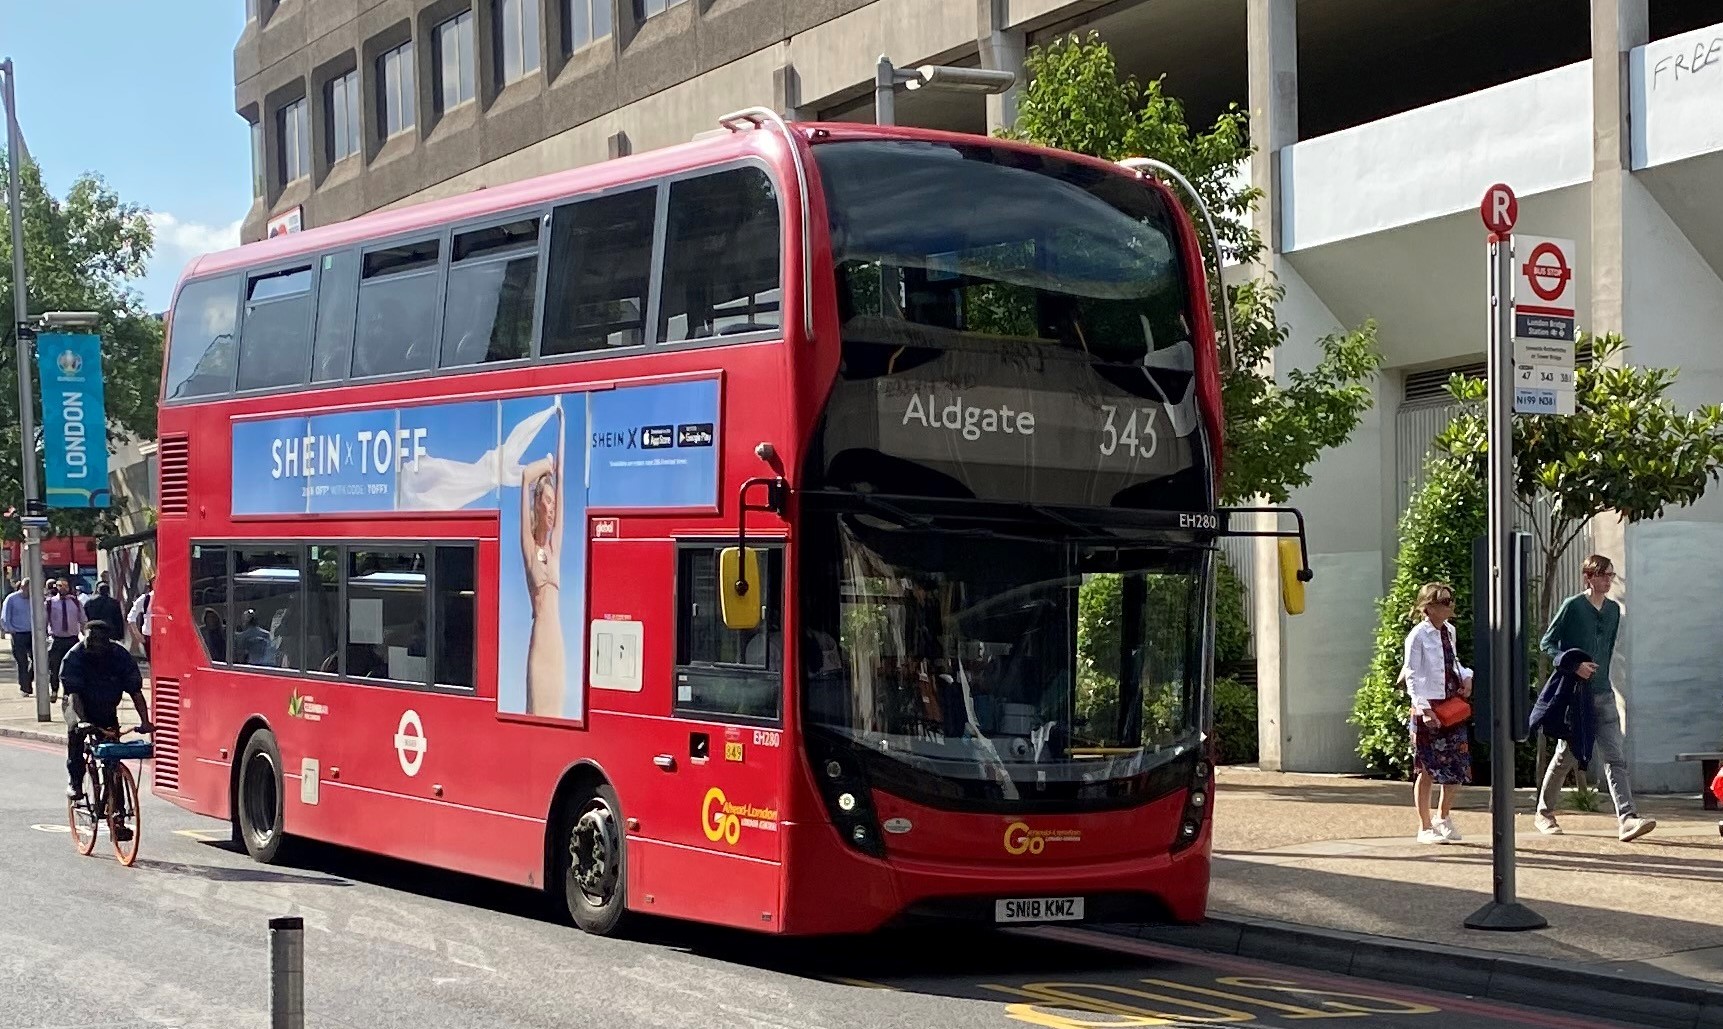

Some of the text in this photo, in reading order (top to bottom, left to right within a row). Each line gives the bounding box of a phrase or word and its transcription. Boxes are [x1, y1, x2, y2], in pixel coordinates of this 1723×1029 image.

[1492, 190, 1512, 226] R
[1534, 266, 1562, 277] BUS STOP
[1528, 327, 1549, 336] Station
[1522, 371, 1531, 380] 47
[1541, 372, 1554, 381] 343
[1516, 395, 1536, 405] N199
[902, 393, 1158, 458] Aldgate 343
[63, 391, 87, 479] LONDON
[592, 431, 624, 448] SHEIN
[271, 433, 341, 479] SHEIN
[357, 427, 427, 475] TOFF
[1179, 513, 1216, 529] EH280
[753, 730, 780, 747] EH280
[1006, 899, 1075, 918] SN18 KMZ
